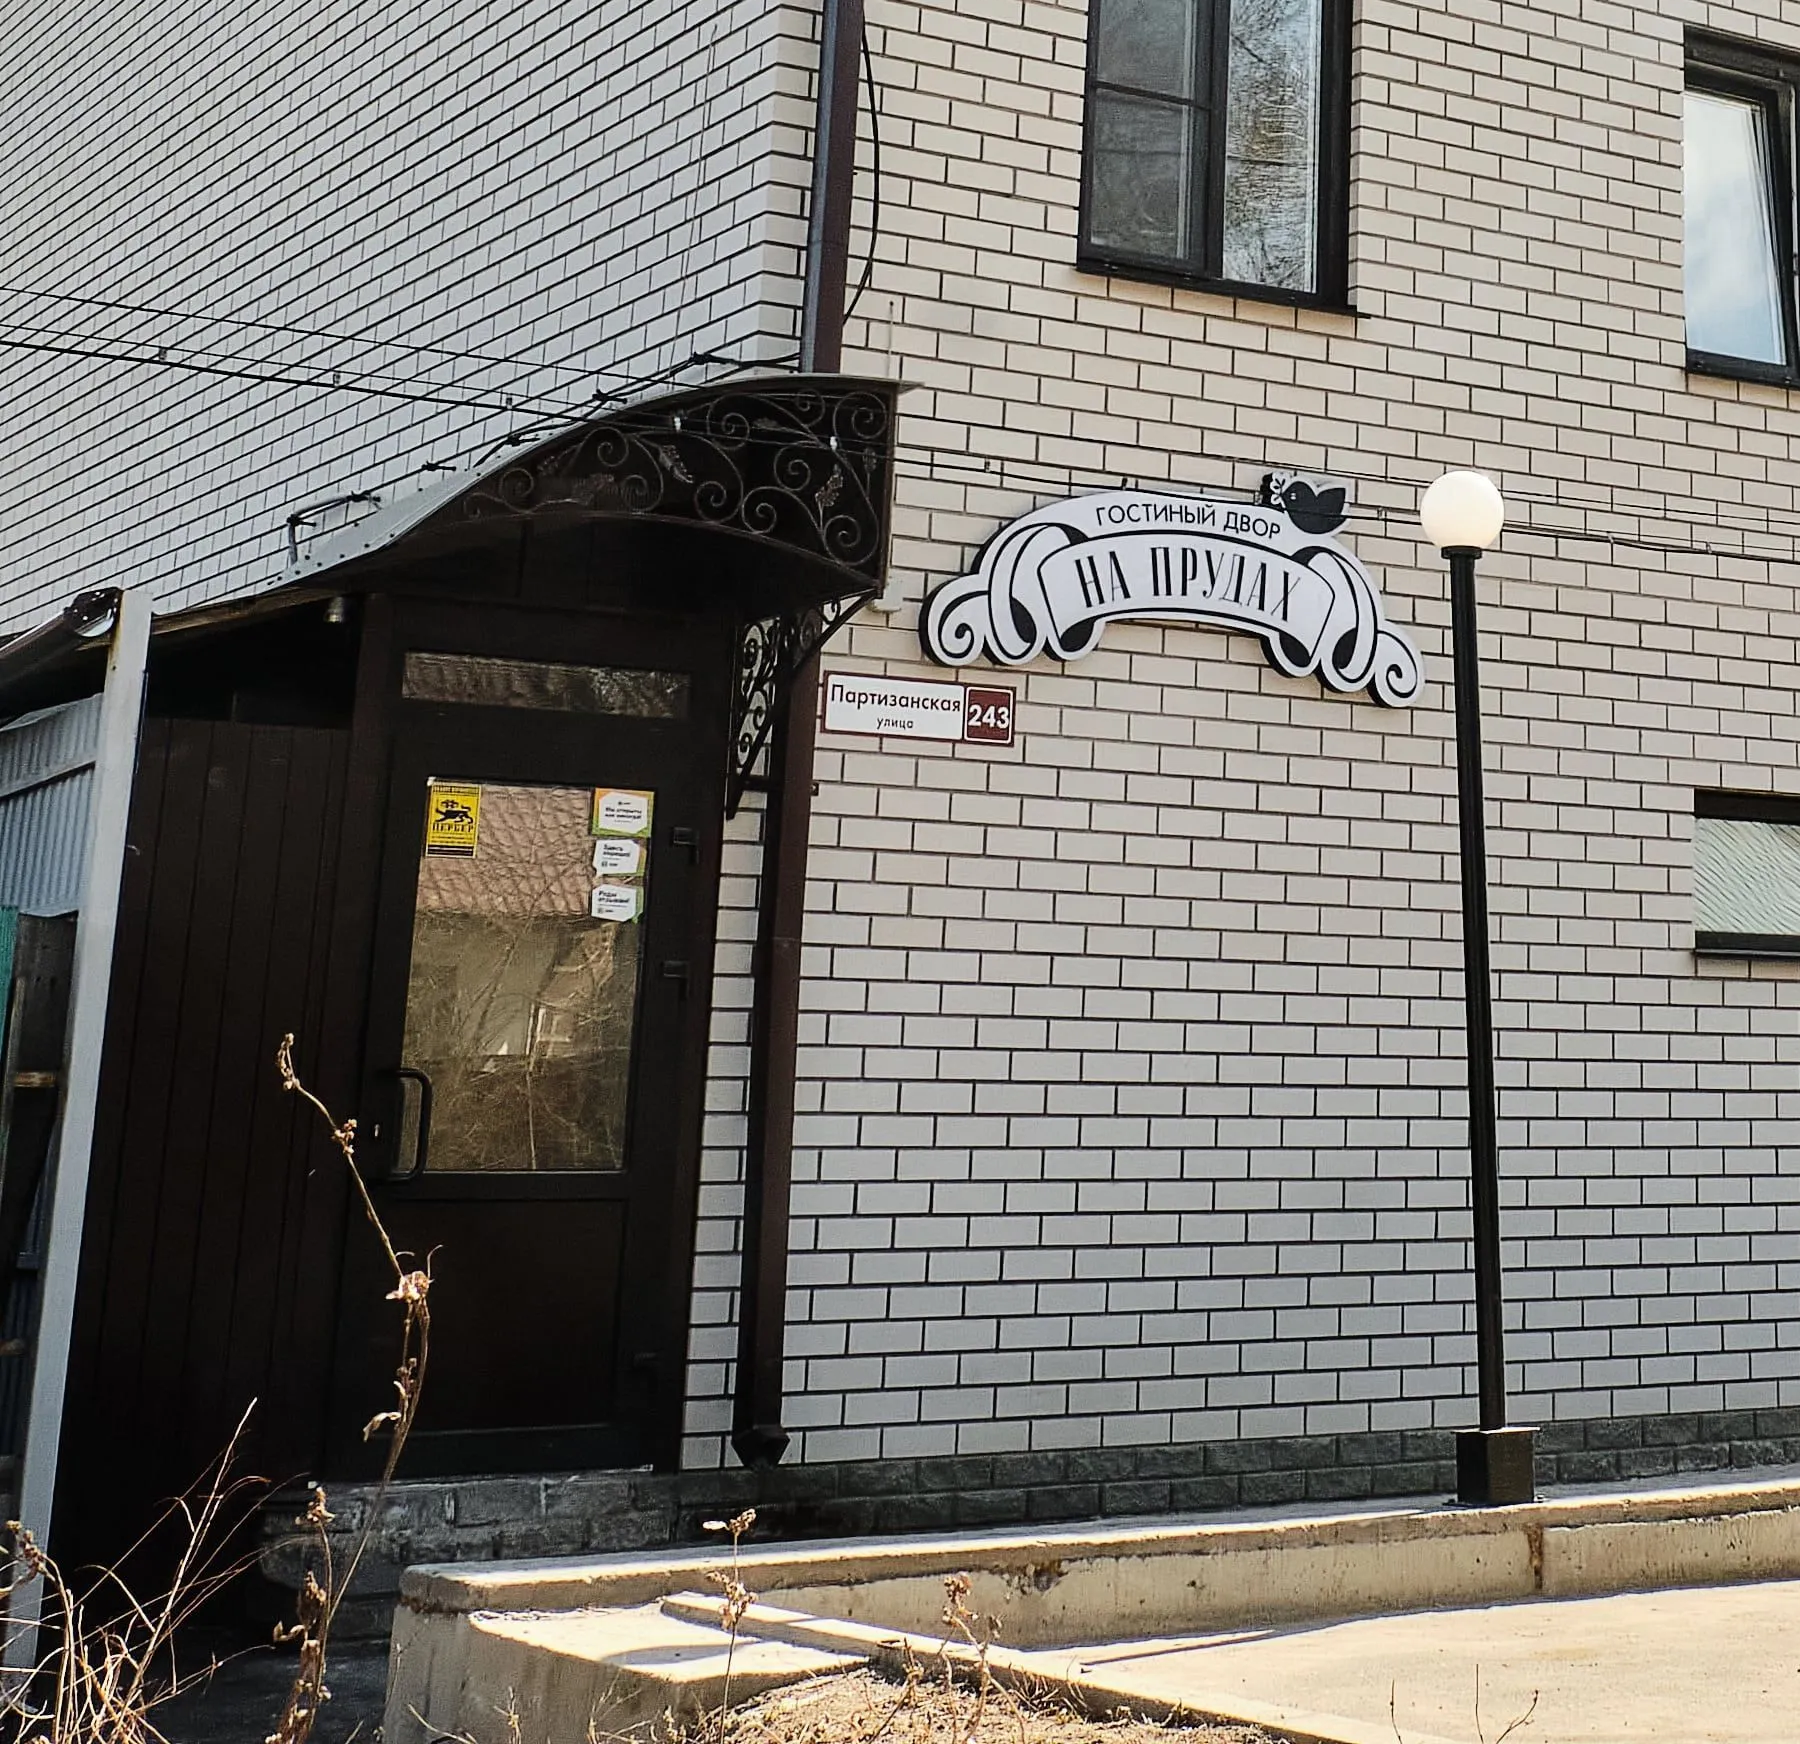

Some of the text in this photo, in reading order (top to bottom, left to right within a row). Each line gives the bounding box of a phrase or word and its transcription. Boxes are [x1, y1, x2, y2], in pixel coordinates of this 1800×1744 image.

[1096, 504, 1281, 539] ГОСТИНЫЙ ДВОР
[1074, 546, 1302, 623] НА ПРУДАХ
[831, 684, 961, 712] Партизанская
[876, 716, 914, 729] улица
[967, 704, 1010, 729] 243
